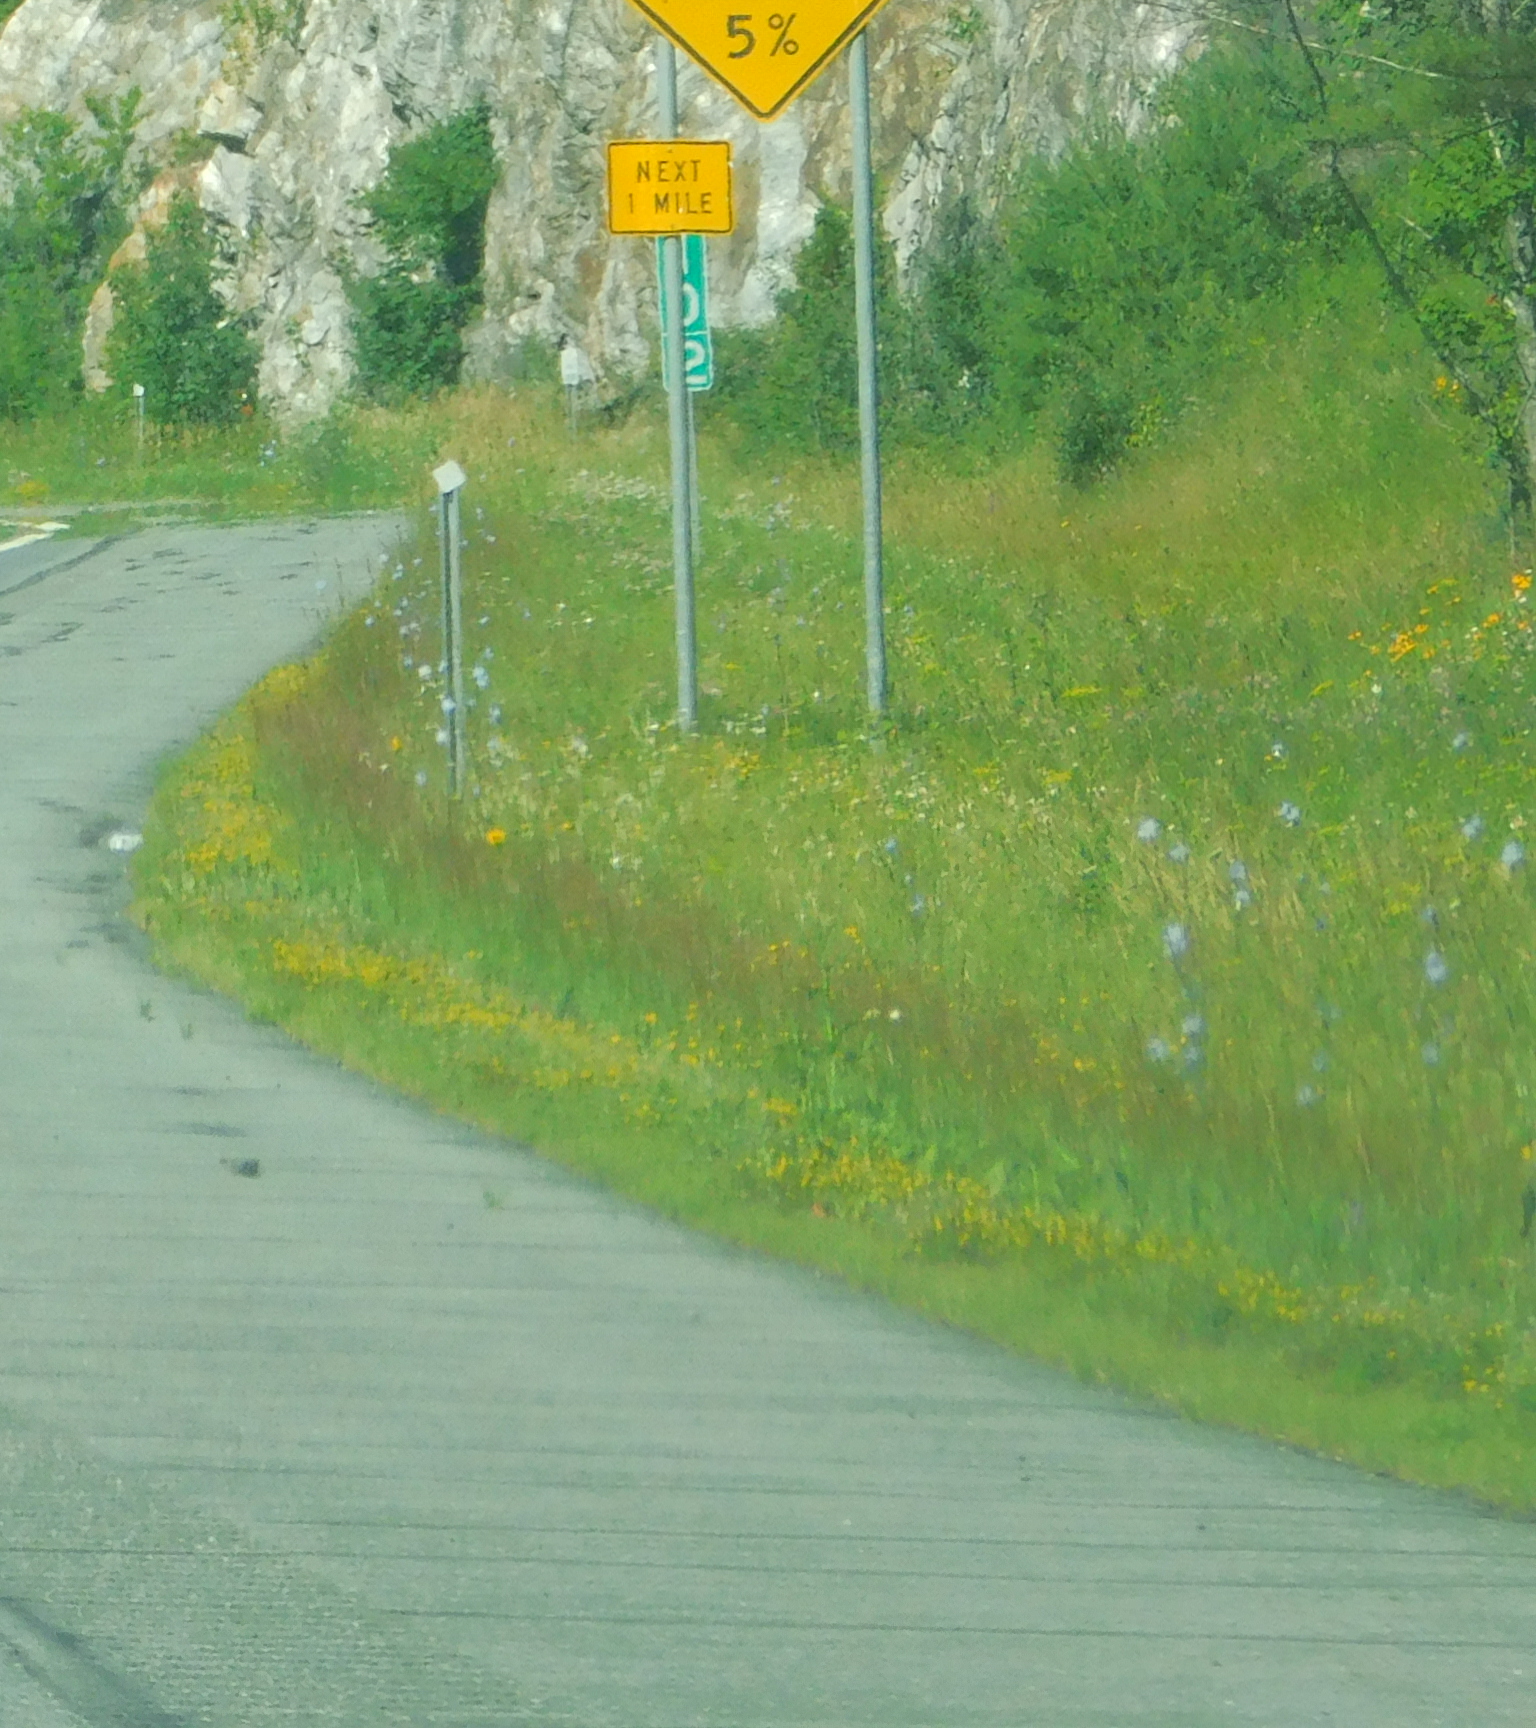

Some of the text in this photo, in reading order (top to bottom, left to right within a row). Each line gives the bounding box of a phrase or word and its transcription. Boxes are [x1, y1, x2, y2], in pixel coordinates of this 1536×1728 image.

[727, 13, 799, 59] 5%
[637, 160, 701, 183] NEXT
[629, 192, 712, 214] 1 MILE
